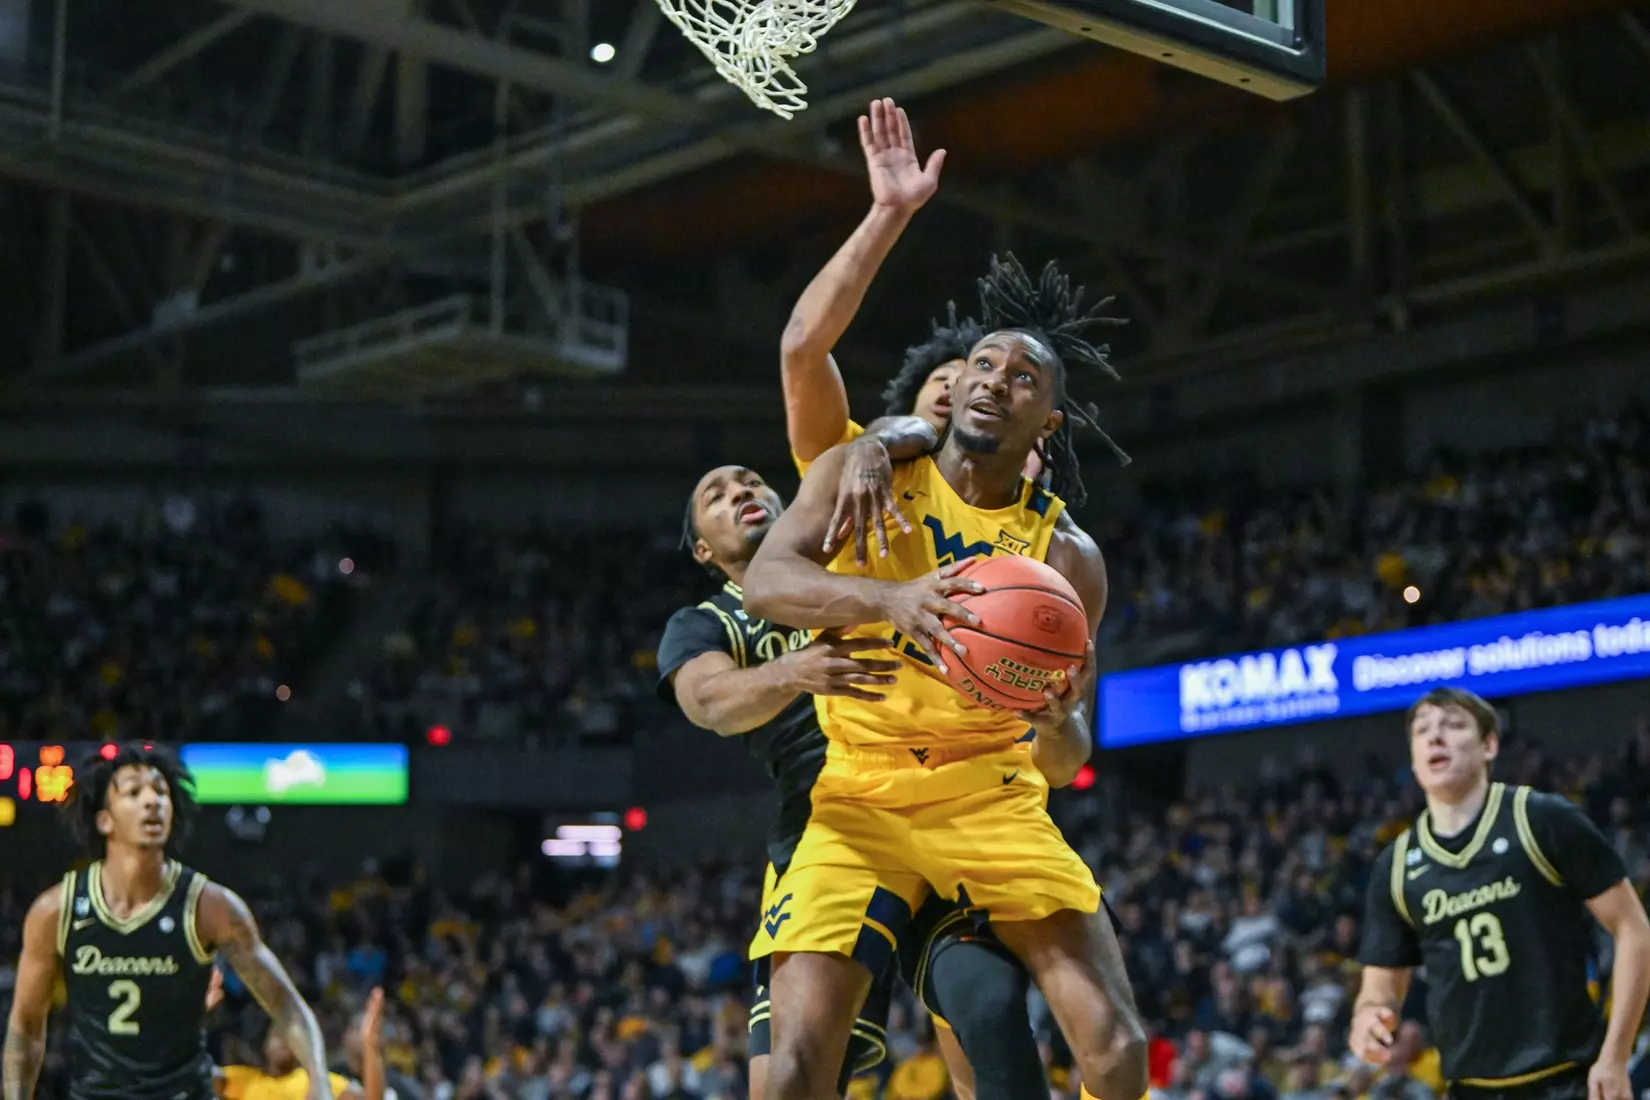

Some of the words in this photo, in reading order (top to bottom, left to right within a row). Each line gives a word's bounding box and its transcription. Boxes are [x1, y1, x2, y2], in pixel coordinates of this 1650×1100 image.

[1179, 643, 1340, 709] KOMAX
[1352, 646, 1466, 692] Discover
[1468, 630, 1593, 676] solutions
[1422, 875, 1522, 925] Deacons
[72, 945, 179, 976] Deacons
[1454, 912, 1511, 983] 13
[107, 979, 141, 1035] 2
